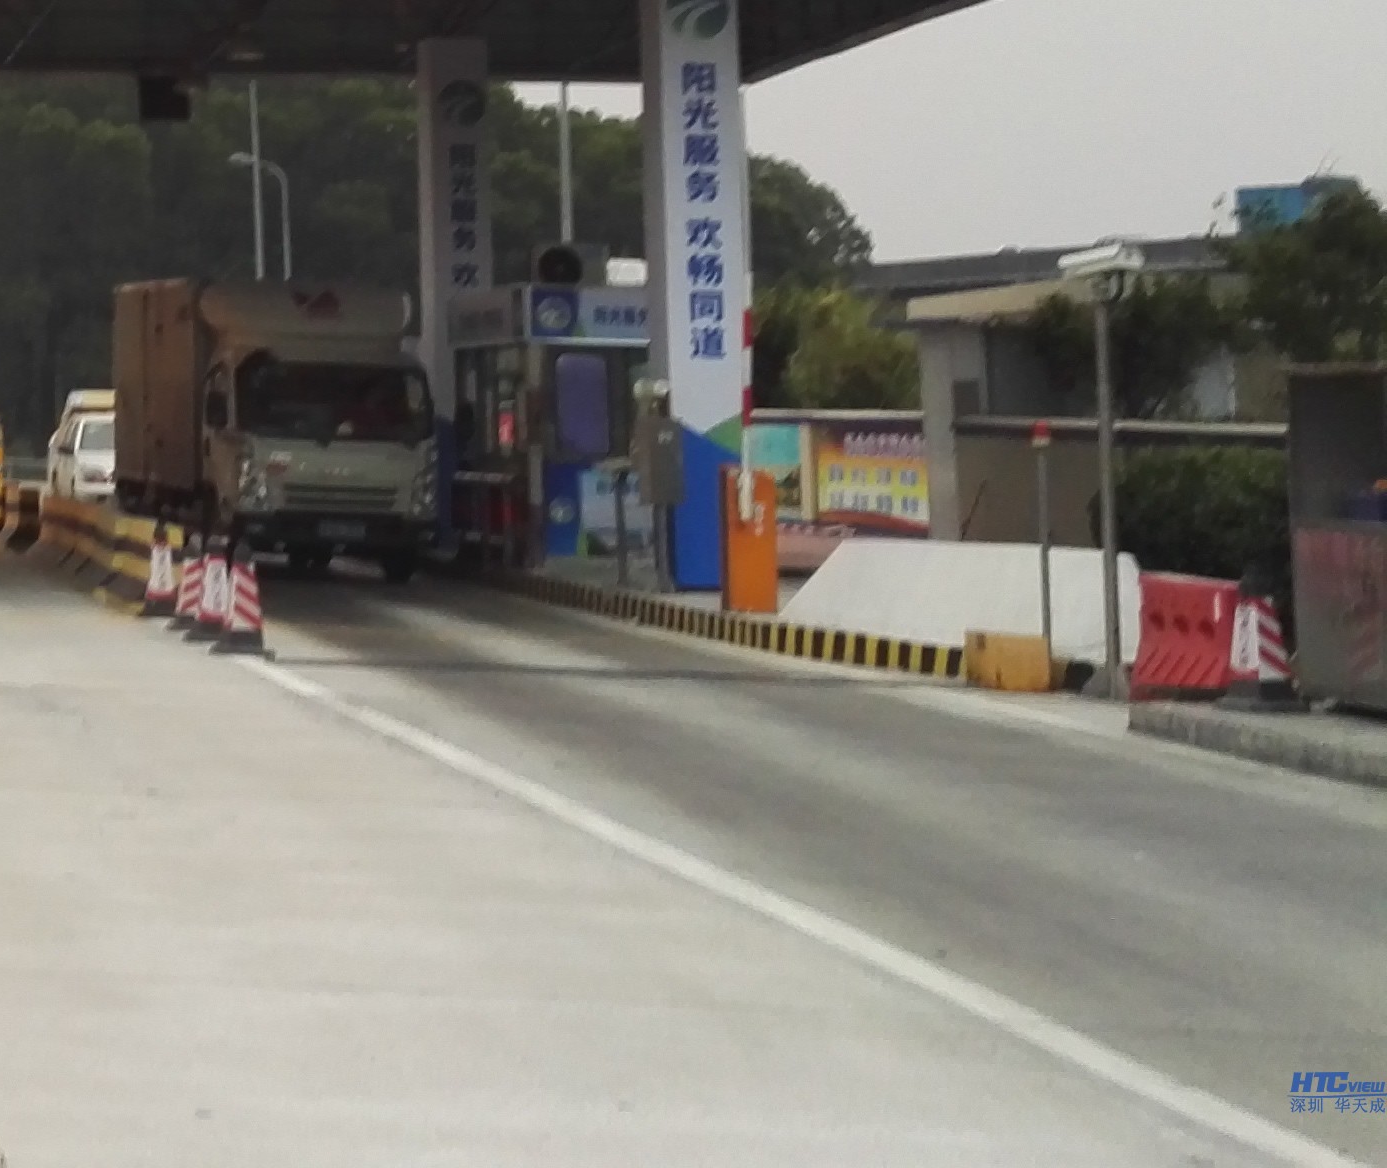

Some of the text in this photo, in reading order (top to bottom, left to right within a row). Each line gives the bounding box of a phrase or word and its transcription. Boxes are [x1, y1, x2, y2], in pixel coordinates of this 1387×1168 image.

[680, 62, 725, 360] 阳光服务 欢畅同道
